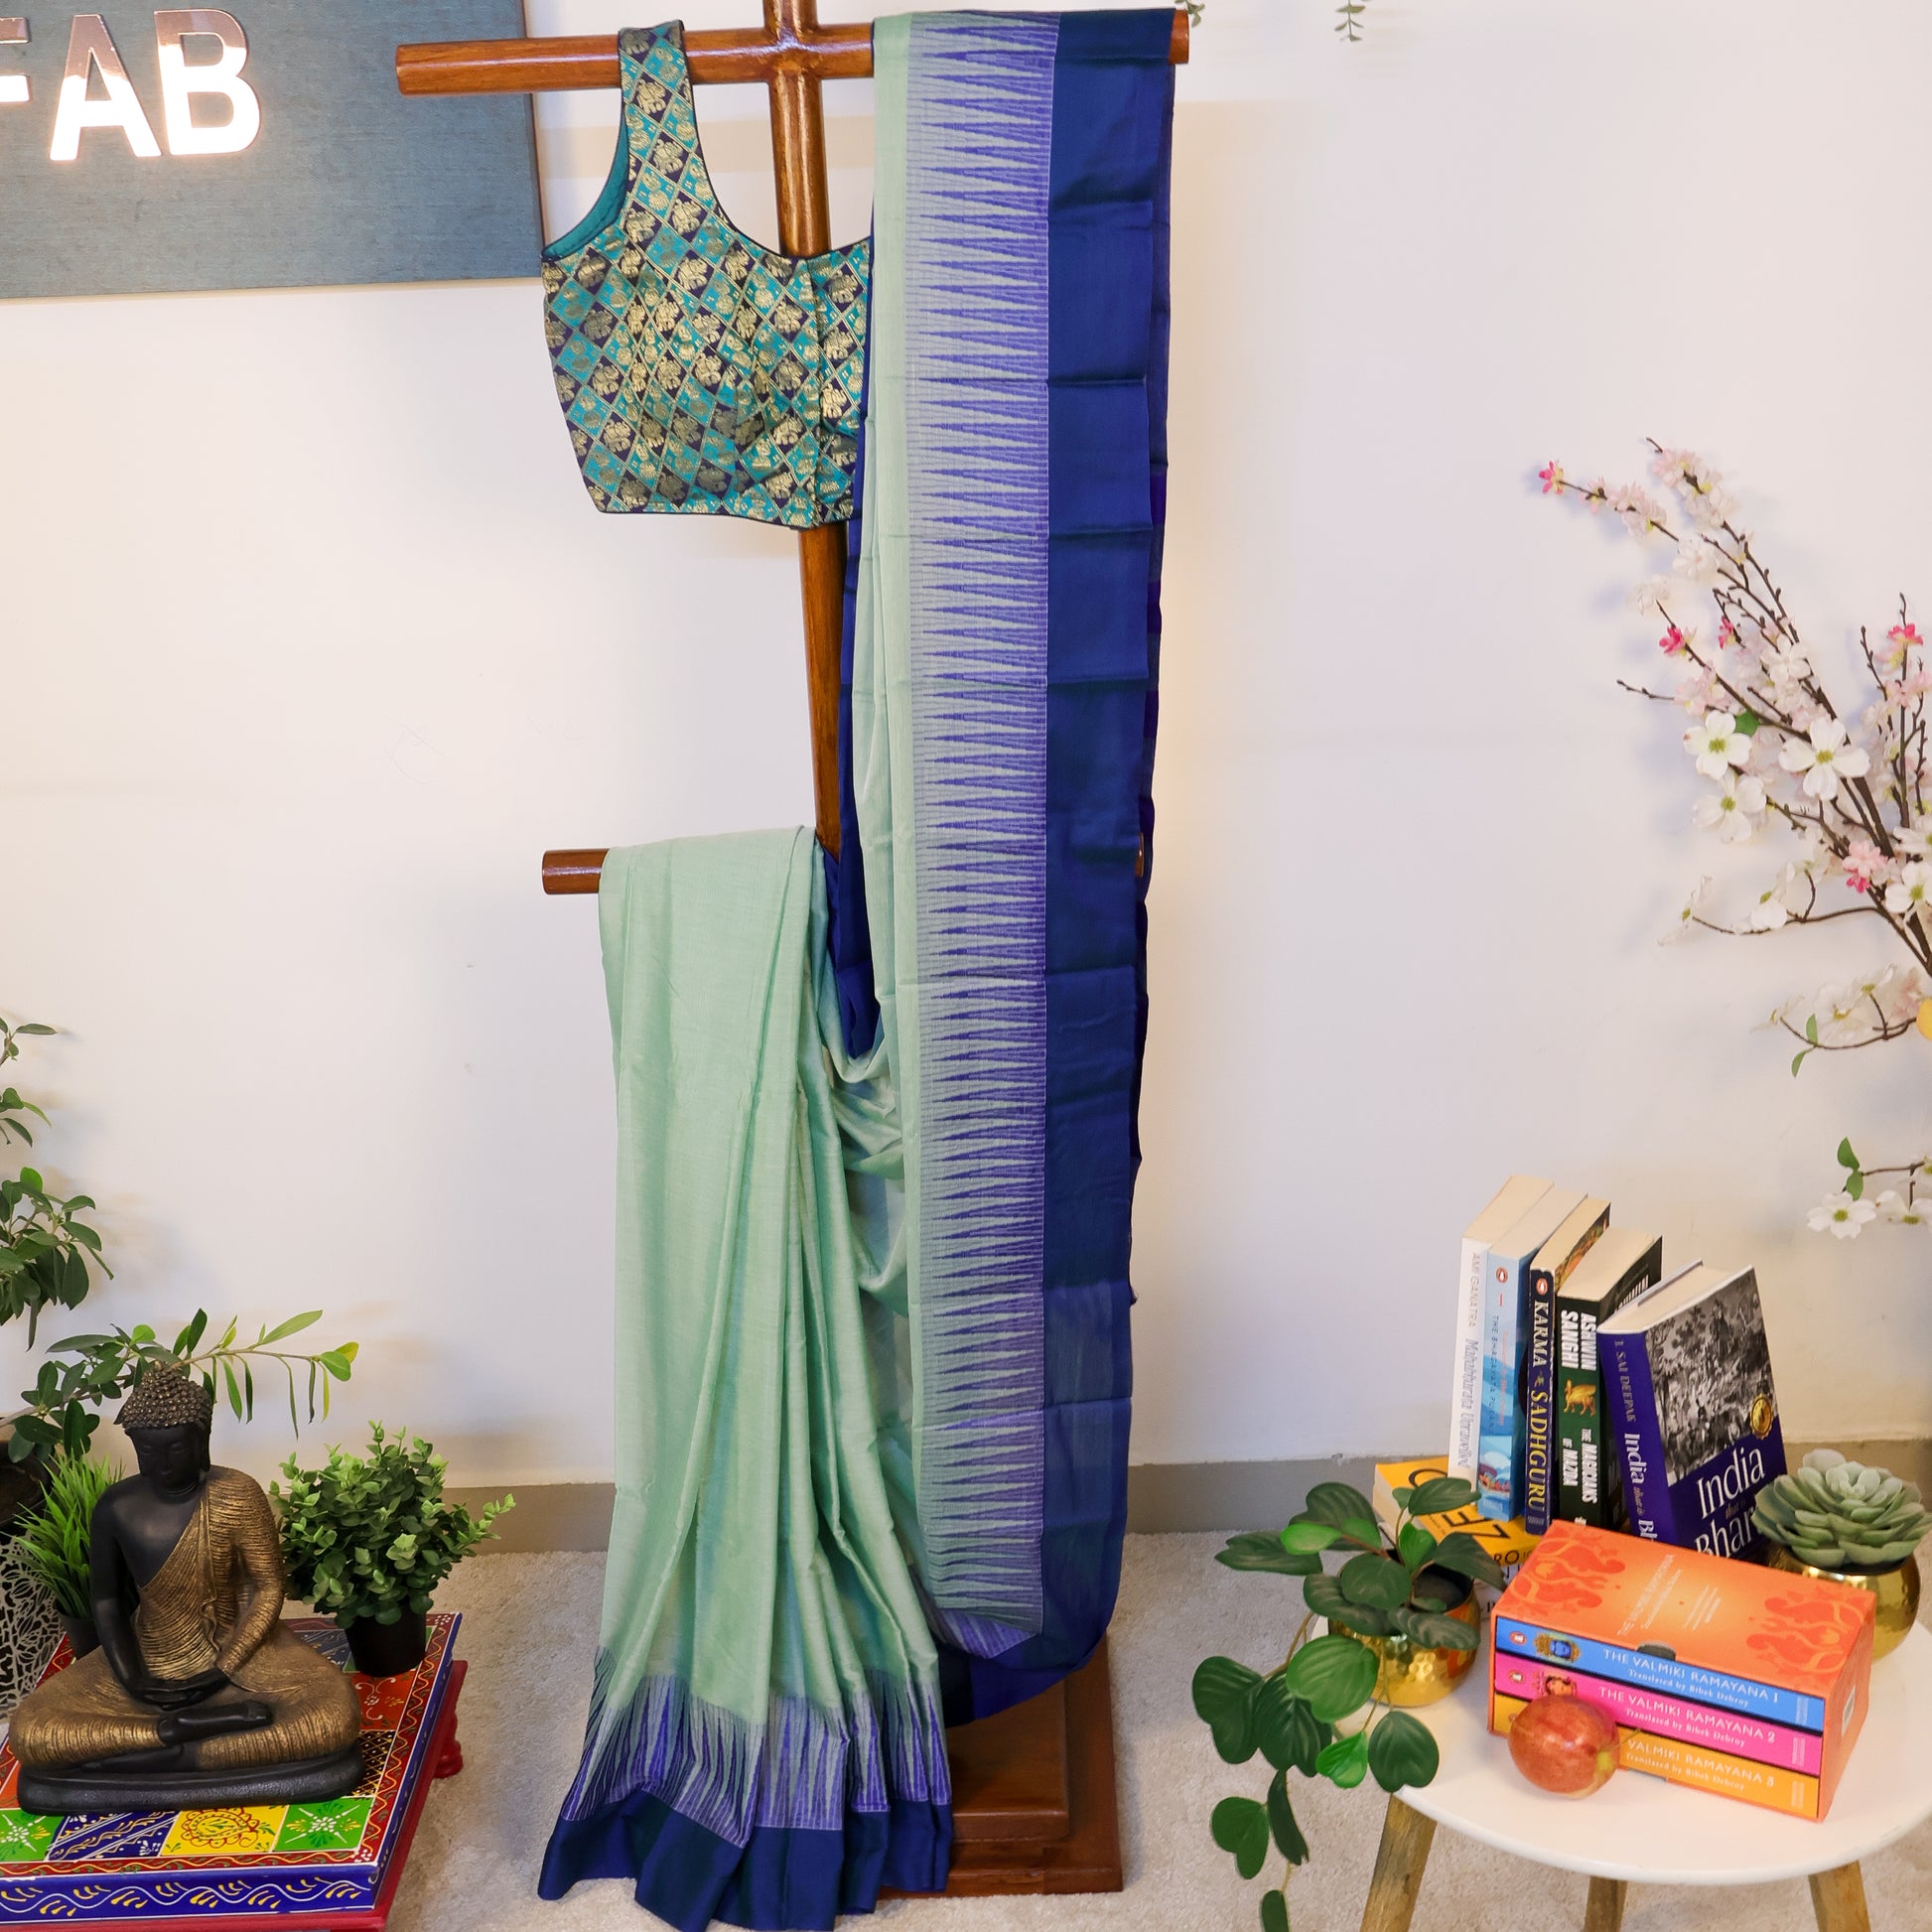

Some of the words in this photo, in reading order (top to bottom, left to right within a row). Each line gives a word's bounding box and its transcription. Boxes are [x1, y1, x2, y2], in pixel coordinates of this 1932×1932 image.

[1532, 1300, 1549, 1368] KARMA
[1561, 1310, 1580, 1369] SANGHI
[1581, 1311, 1596, 1371] ASHWIN
[1616, 1351, 1628, 1373] SAI
[1620, 1375, 1636, 1423] DEEPAK
[1528, 1390, 1548, 1511] SADHGURU
[1562, 1437, 1573, 1449] OF
[1582, 1428, 1591, 1443] THE
[1624, 1433, 1647, 1484] India
[1563, 1448, 1579, 1487] MAZDA
[1582, 1443, 1597, 1504] MAGICIANS
[1696, 1447, 1766, 1520] India
[1603, 1649, 1628, 1665] THE
[1632, 1656, 1686, 1679] VALMIKI
[1690, 1671, 1769, 1701] RAMAYANA
[1629, 1668, 1673, 1687] Translated
[1675, 1680, 1686, 1692] by
[1689, 1682, 1714, 1698] Bibek
[1717, 1690, 1748, 1708] Debroy
[1598, 1686, 1625, 1704] THE
[1628, 1694, 1681, 1718] VALMIKI
[1686, 1709, 1763, 1739] RAMAYANA
[1767, 1730, 1775, 1743] 2
[1626, 1707, 1670, 1725] Translated
[1672, 1720, 1683, 1731] by
[1686, 1723, 1710, 1737] Bibek
[1713, 1729, 1745, 1748] Debroy
[1626, 1752, 1670, 1770] Translated
[1672, 1763, 1682, 1774] by
[1713, 1775, 1745, 1791] Debroy
[1627, 1738, 1681, 1761] VALMIKI
[1685, 1754, 1763, 1782] RAMAYANA
